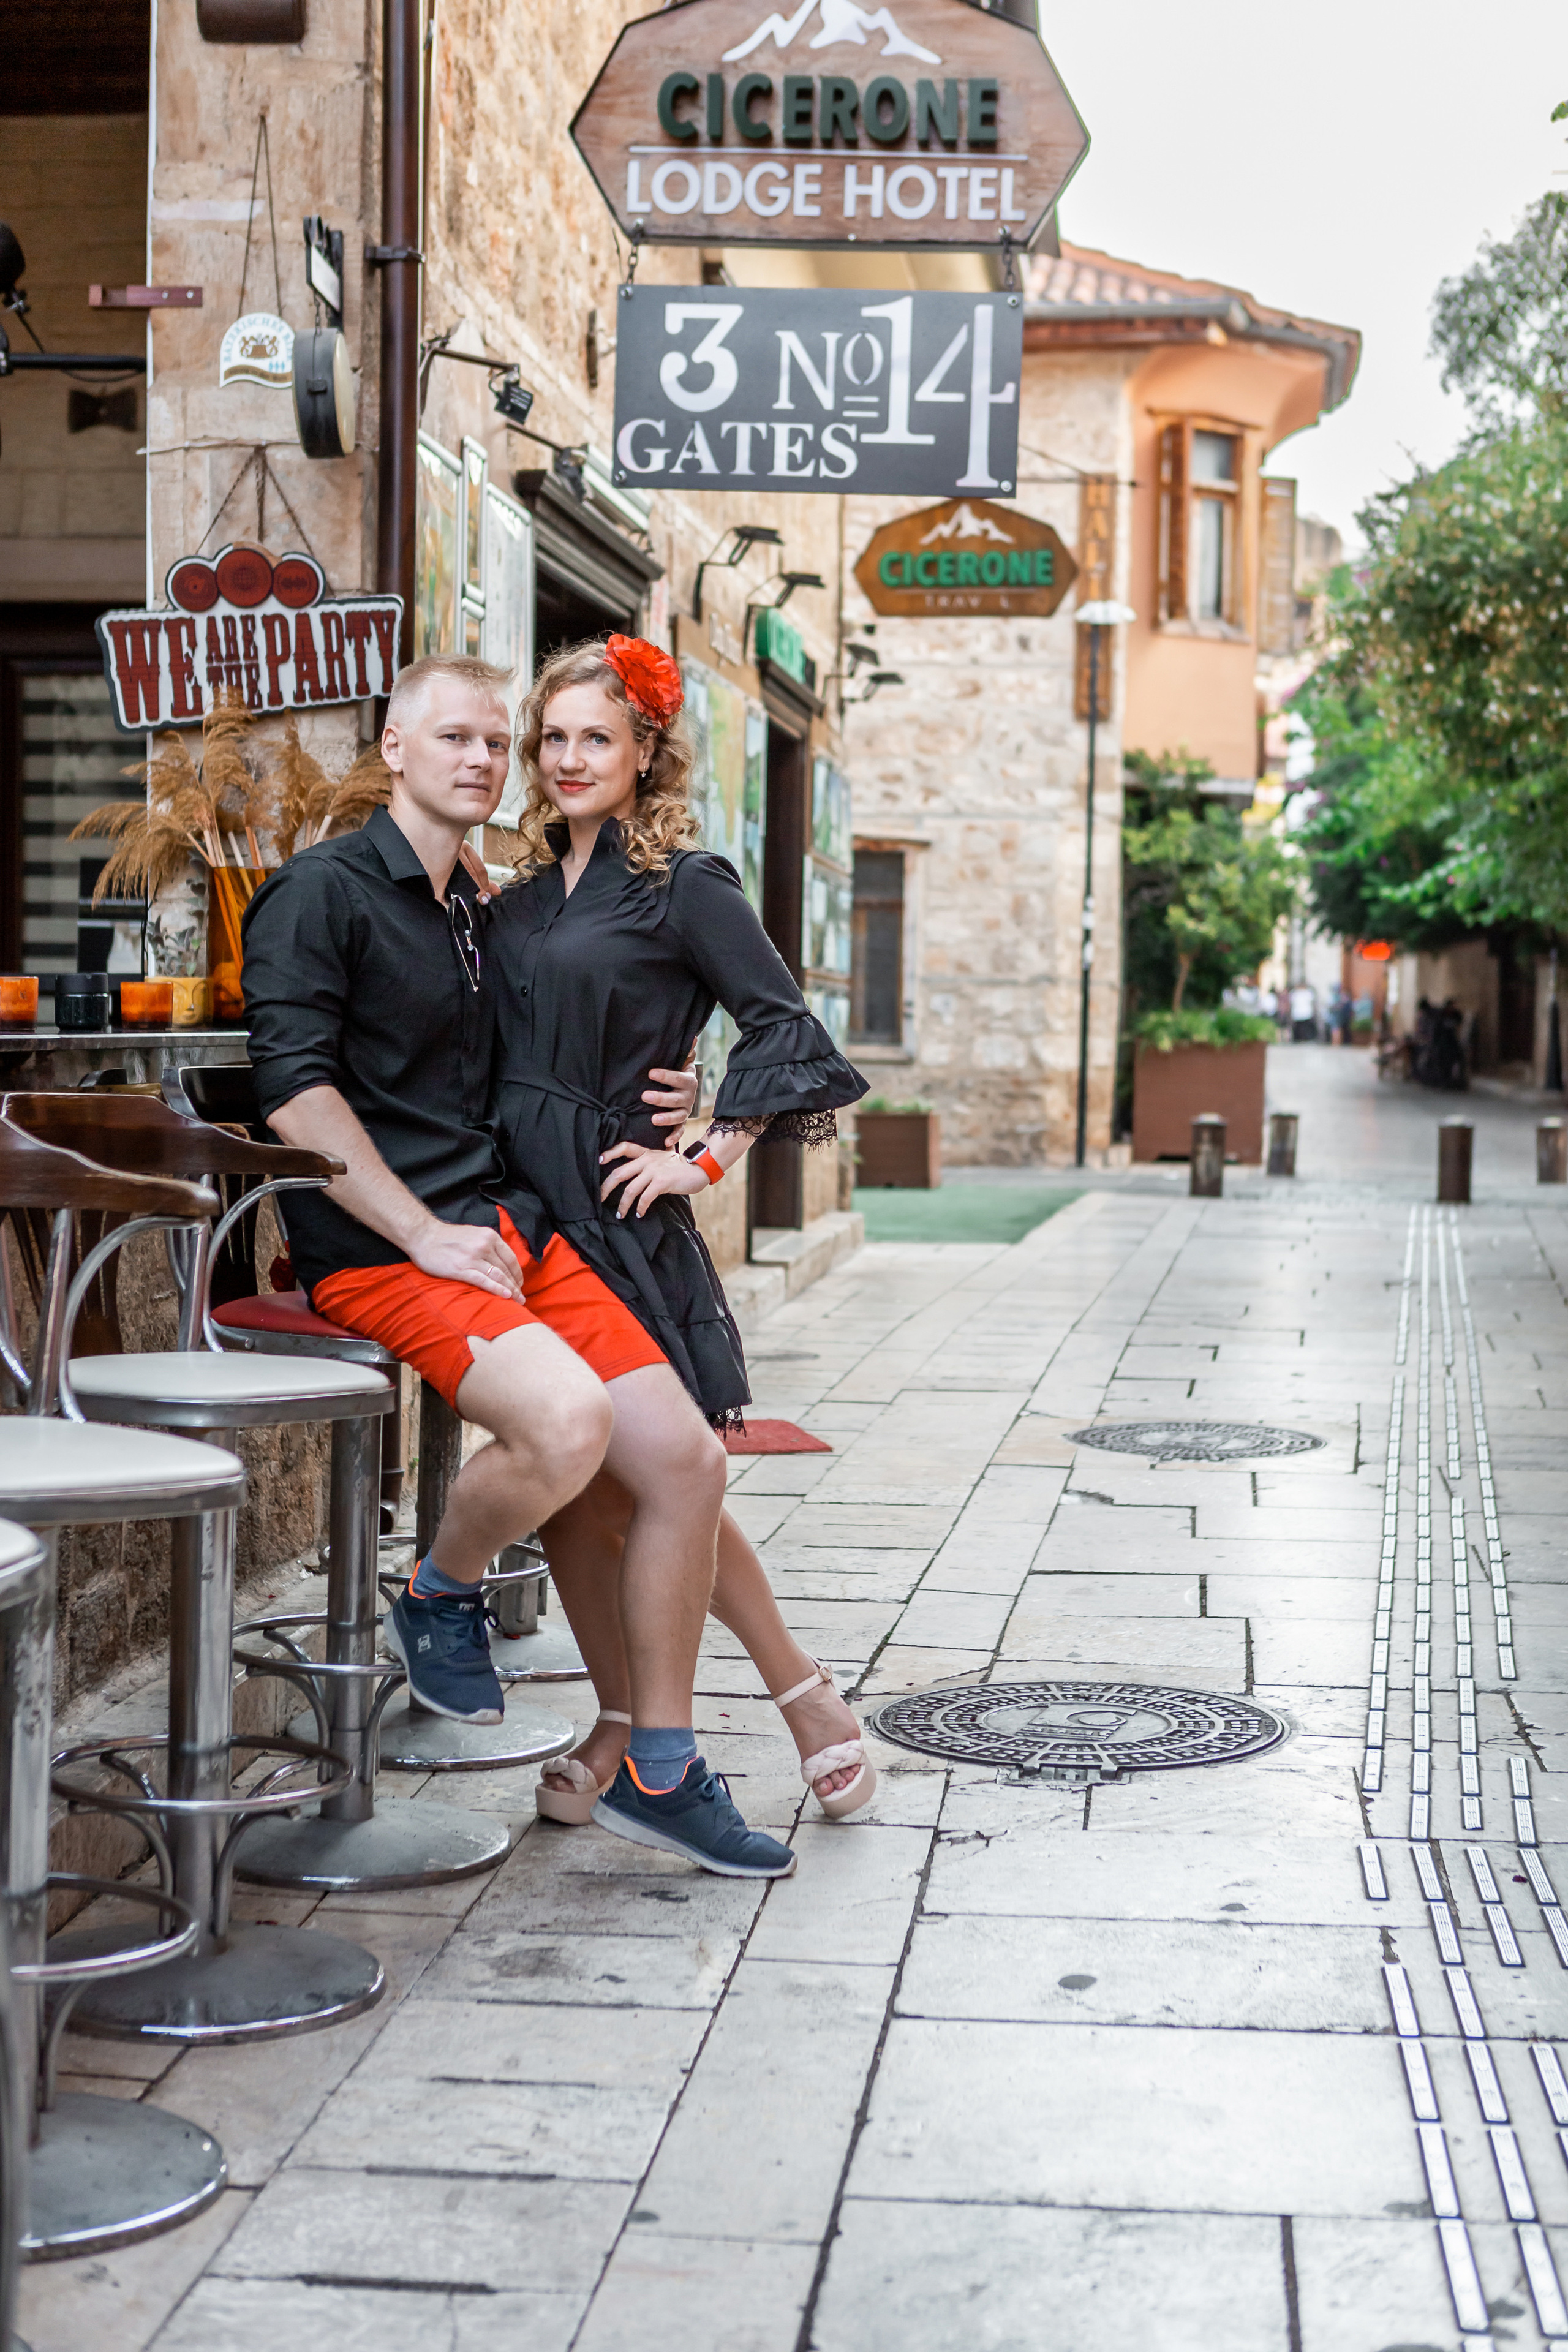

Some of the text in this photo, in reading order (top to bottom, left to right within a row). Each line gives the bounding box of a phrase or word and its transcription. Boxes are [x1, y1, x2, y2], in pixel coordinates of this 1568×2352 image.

[657, 71, 1000, 148] CICERONE
[626, 160, 1027, 221] LODGE HOTEL
[659, 302, 744, 413] 3
[616, 418, 859, 479] GATES
[879, 549, 1054, 587] CICERONE
[107, 617, 205, 723] WE
[206, 614, 258, 664] ARE
[262, 609, 397, 707] PARTY
